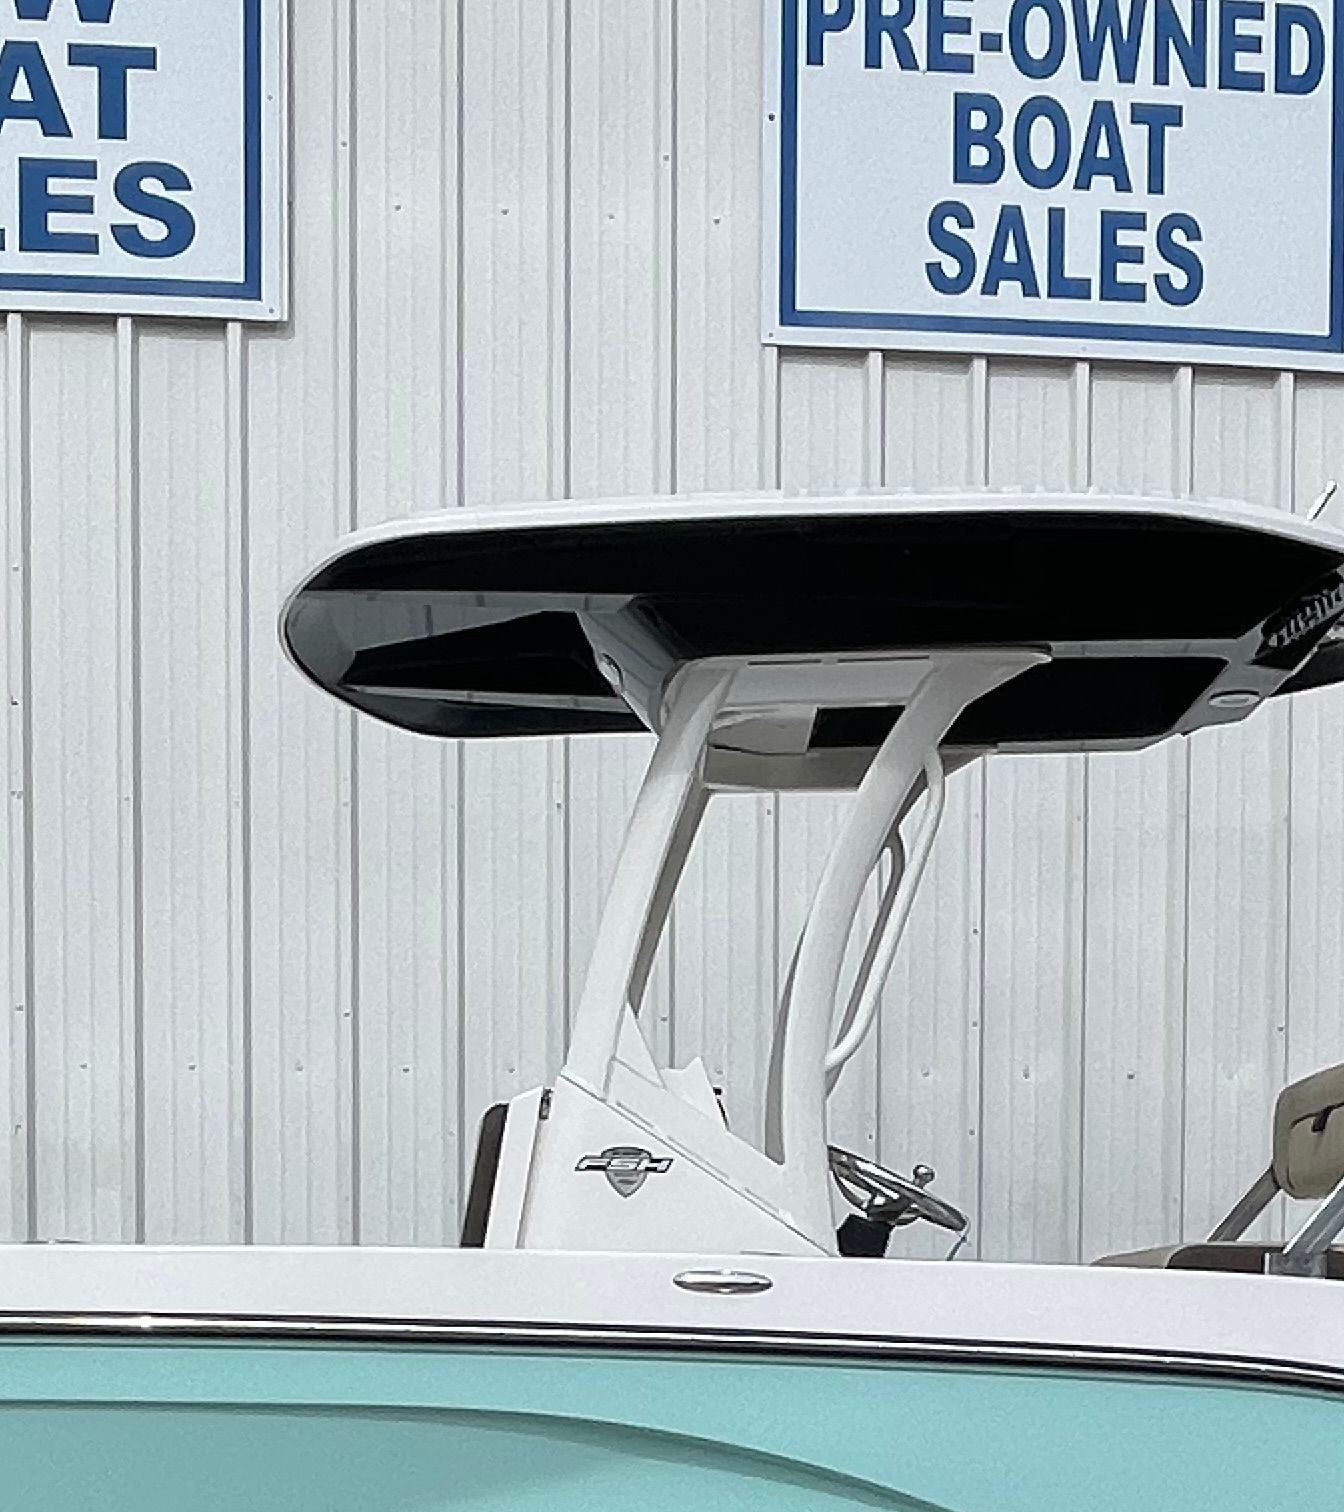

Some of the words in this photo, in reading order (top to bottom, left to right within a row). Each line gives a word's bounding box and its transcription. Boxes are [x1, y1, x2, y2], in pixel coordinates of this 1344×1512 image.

[806, 0, 1326, 96] PRE-OWNED
[952, 92, 1183, 196] BOAT
[925, 201, 1204, 308] SALES
